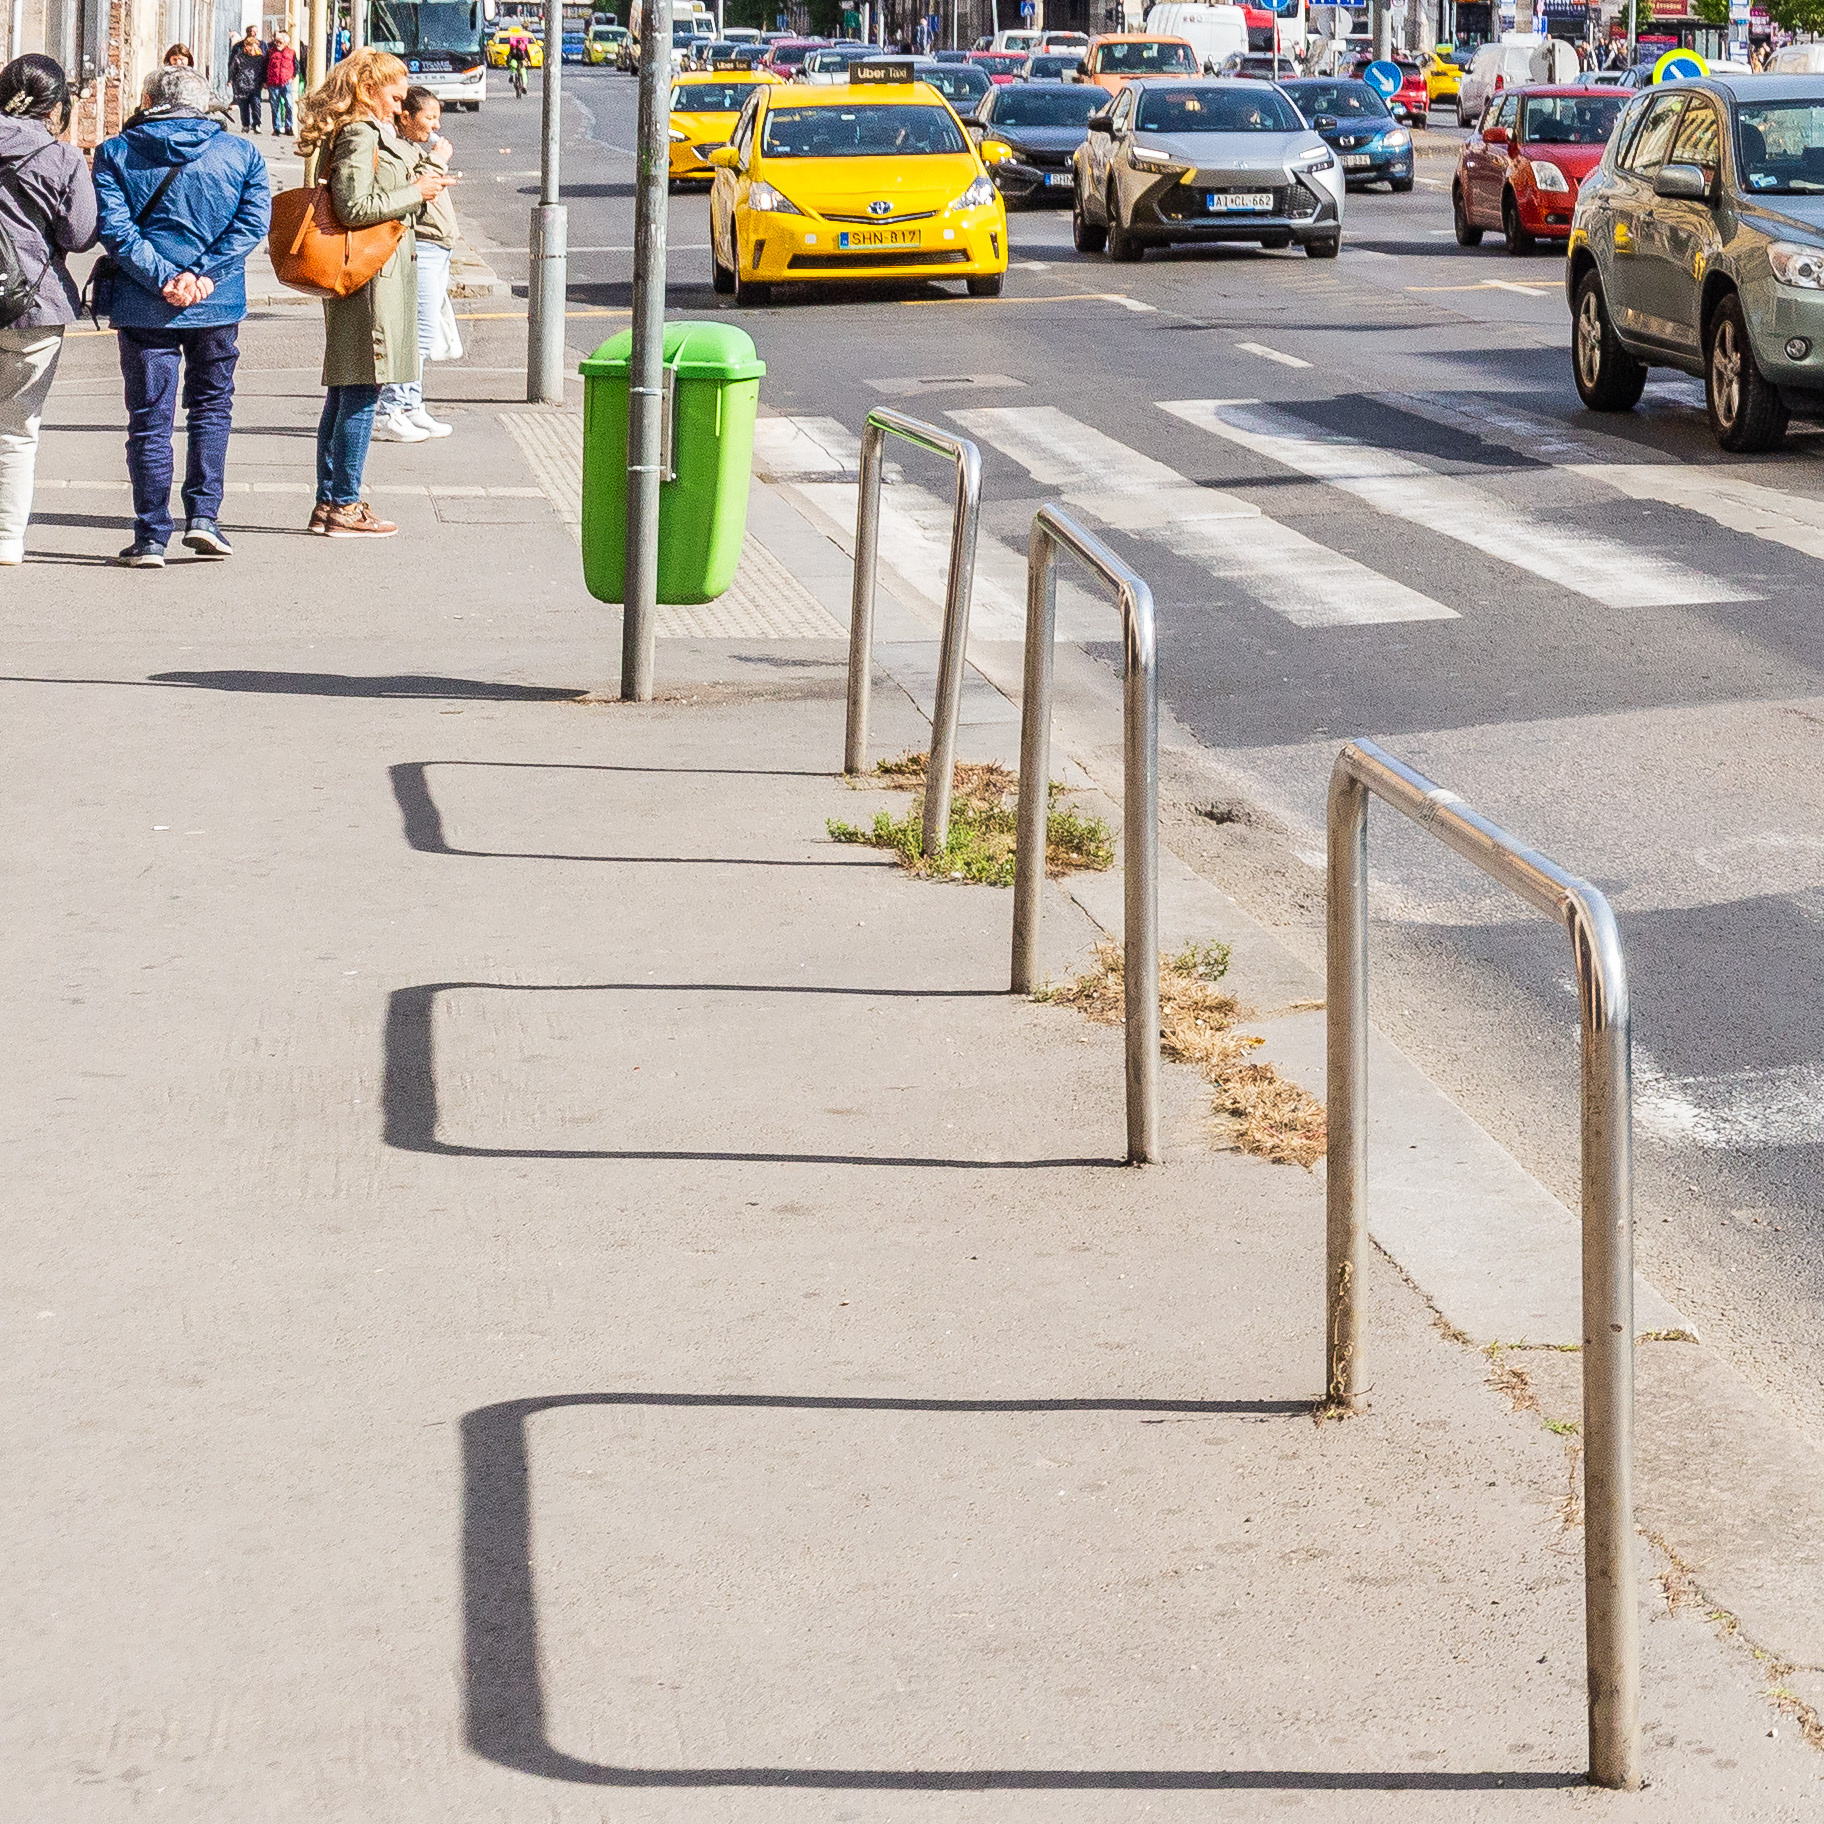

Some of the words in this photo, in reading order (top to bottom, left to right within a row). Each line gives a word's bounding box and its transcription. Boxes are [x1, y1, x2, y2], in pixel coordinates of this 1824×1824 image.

[715, 60, 734, 70] Uber
[857, 67, 886, 79] Uber
[888, 67, 908, 79] Taxi
[852, 231, 916, 245] SHN-817
